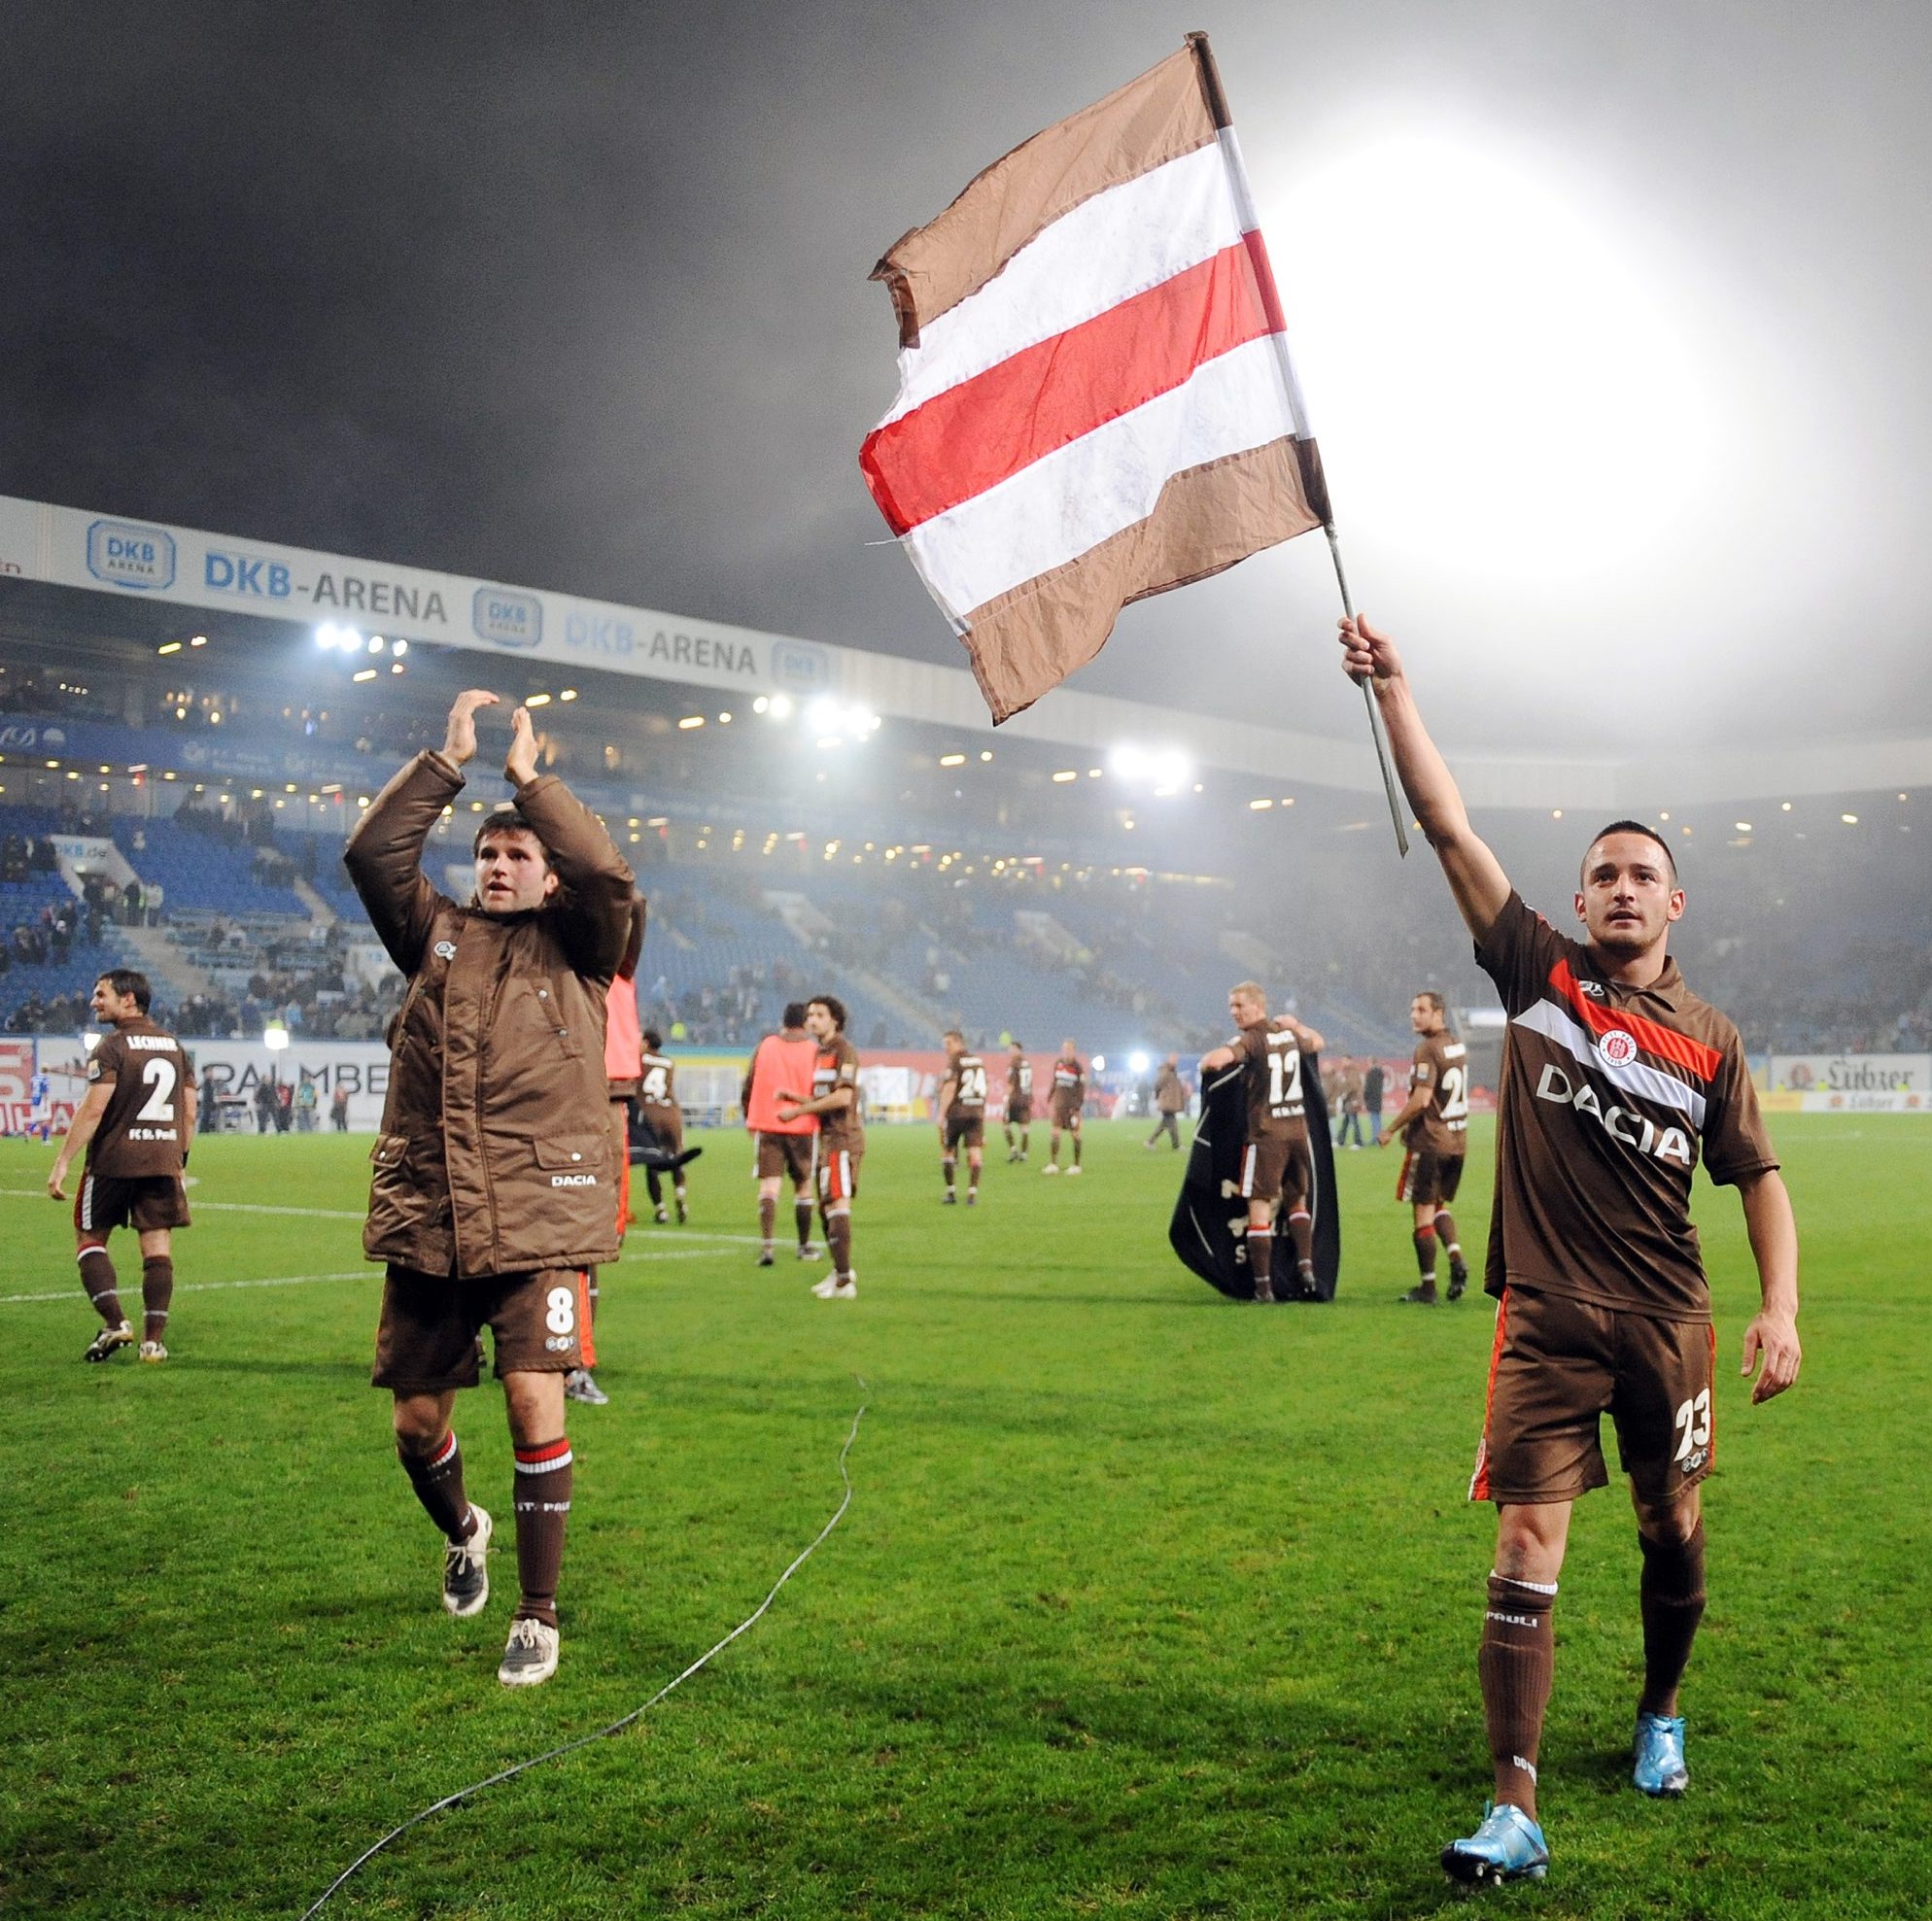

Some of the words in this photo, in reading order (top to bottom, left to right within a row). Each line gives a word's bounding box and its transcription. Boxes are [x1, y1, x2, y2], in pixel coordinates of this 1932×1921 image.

[108, 536, 155, 561] DKB
[108, 560, 155, 573] ARENA
[205, 552, 448, 624] DKB-ARENA
[566, 612, 756, 675] DKB-ARENA
[137, 1057, 176, 1121] 2
[1267, 1049, 1303, 1105] 12
[1536, 1063, 1690, 1166] DACIA
[551, 1174, 598, 1187] DACIA
[546, 1286, 574, 1335] 8
[1673, 1387, 1710, 1462] 23
